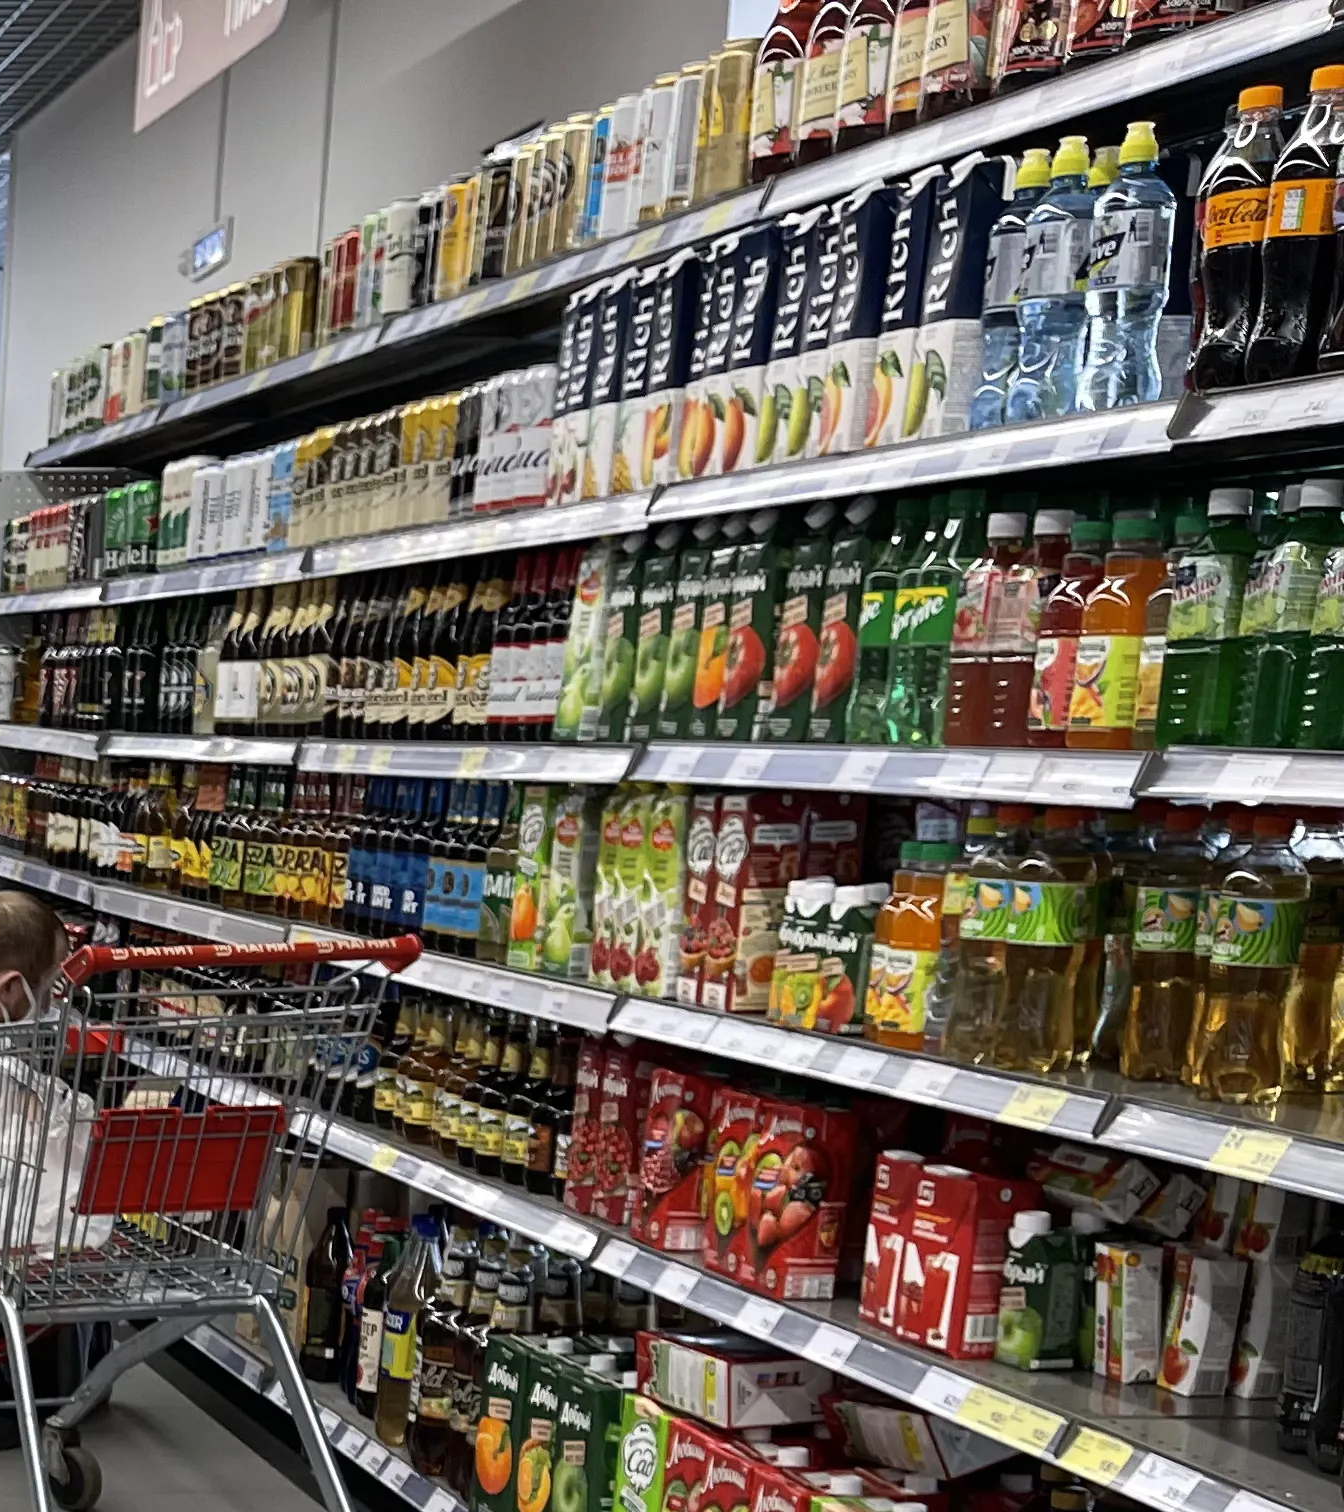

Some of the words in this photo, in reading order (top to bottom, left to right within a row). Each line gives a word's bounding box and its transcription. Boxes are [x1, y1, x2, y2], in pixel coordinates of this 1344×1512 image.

[732, 256, 769, 360] Rich
[771, 245, 806, 351] Rich
[806, 234, 841, 342] Rich
[833, 222, 859, 333] Rich
[882, 208, 913, 323] Rich
[924, 197, 960, 315] Rich
[623, 296, 655, 392] Rich
[132, 944, 194, 958] МАГНИТ
[234, 942, 296, 955] МАГНИТ
[336, 938, 397, 951] МАГНИТ
